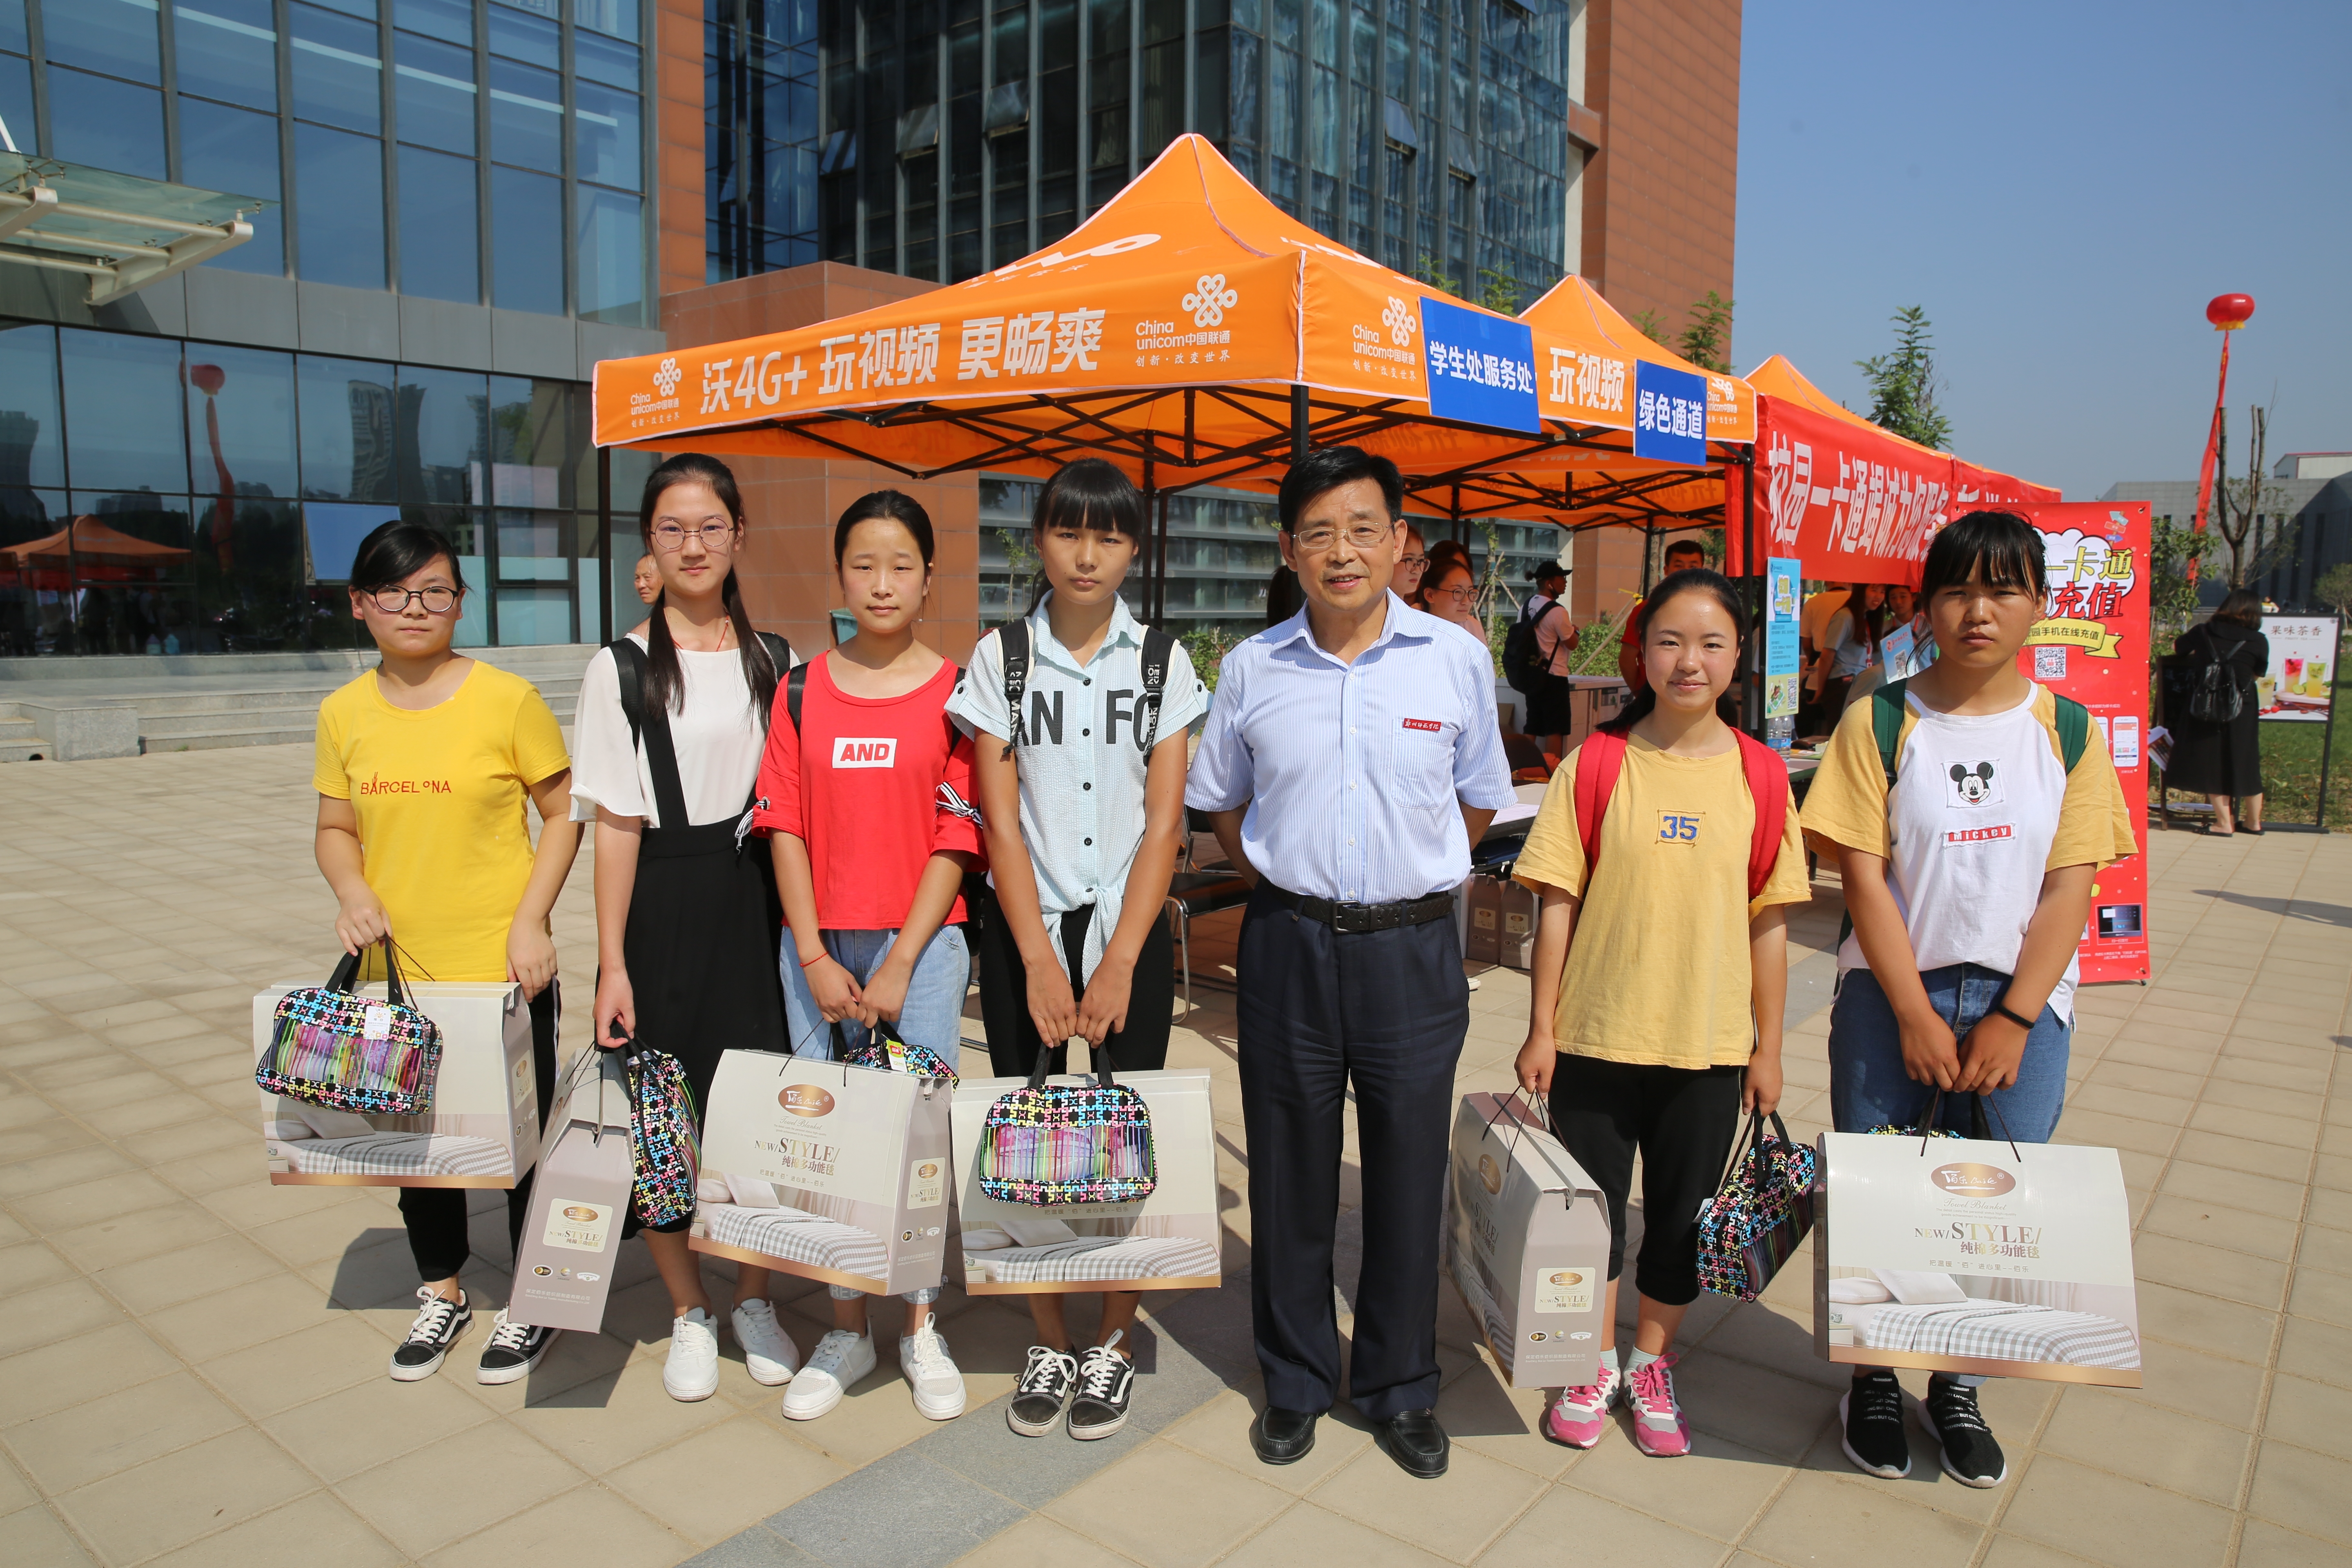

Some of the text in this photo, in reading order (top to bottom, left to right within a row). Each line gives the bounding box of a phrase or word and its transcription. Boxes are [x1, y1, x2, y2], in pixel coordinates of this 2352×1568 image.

[1136, 320, 1174, 336] China
[1353, 324, 1379, 343] China
[819, 323, 940, 392] 玩视频
[958, 307, 1106, 381] 更畅爽
[1429, 340, 1534, 394] 学生处服务处
[1549, 347, 1625, 412] 玩视频
[630, 393, 650, 405] China
[1707, 390, 1720, 402] China
[1638, 389, 1703, 439] 绿色通道
[2050, 581, 2127, 620] 充值
[2029, 627, 2100, 640] 园手机在线充值
[2270, 626, 2322, 636] 果味茶香
[840, 744, 890, 762] AND
[1661, 816, 1699, 840] 35
[780, 1116, 822, 1130] Towel Blanket
[782, 1155, 834, 1176] 纯棉多功能毯
[1944, 1198, 2007, 1210] Towel Blanket
[1960, 1241, 2040, 1258] 纯棉多功能毯
